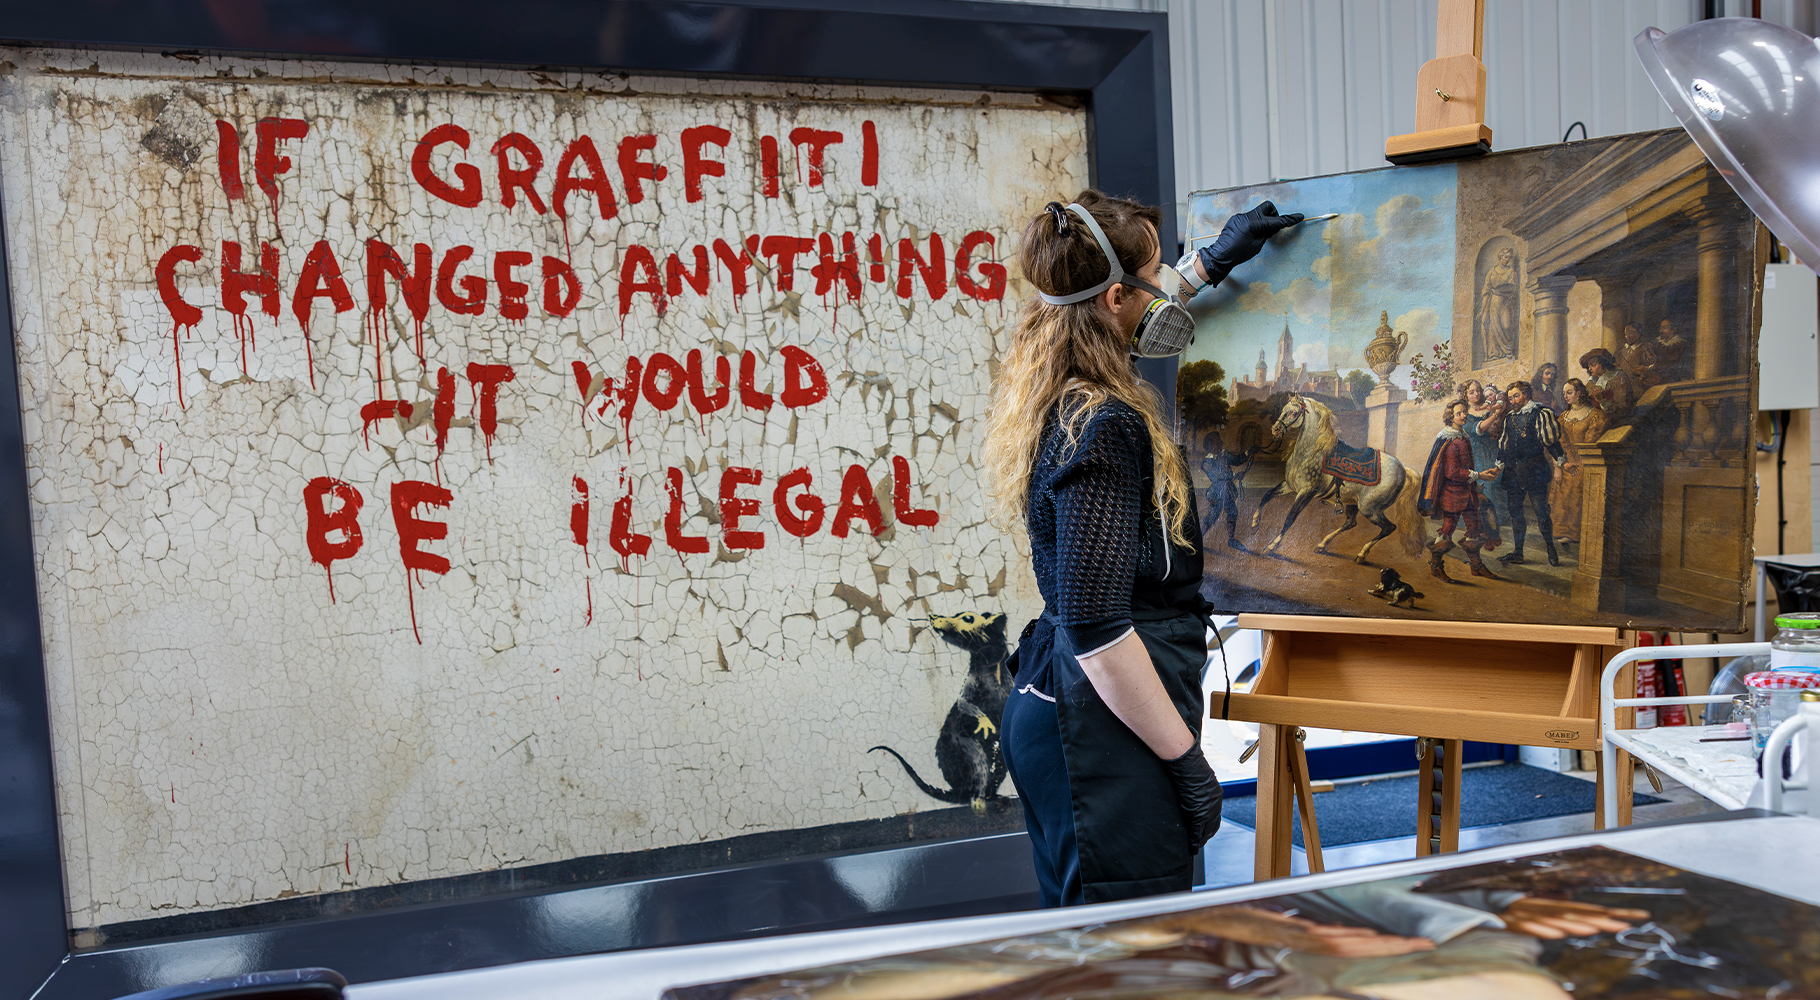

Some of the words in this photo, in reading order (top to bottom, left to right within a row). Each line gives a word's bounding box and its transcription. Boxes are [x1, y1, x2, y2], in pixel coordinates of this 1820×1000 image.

[216, 117, 309, 206] IF
[411, 120, 881, 221] GRAFFITI
[155, 239, 583, 328] CHANGED
[617, 231, 1009, 315] ANYTHING
[572, 345, 829, 428] WOULD
[303, 476, 455, 575] BE
[569, 456, 940, 564] ILLEGAL
